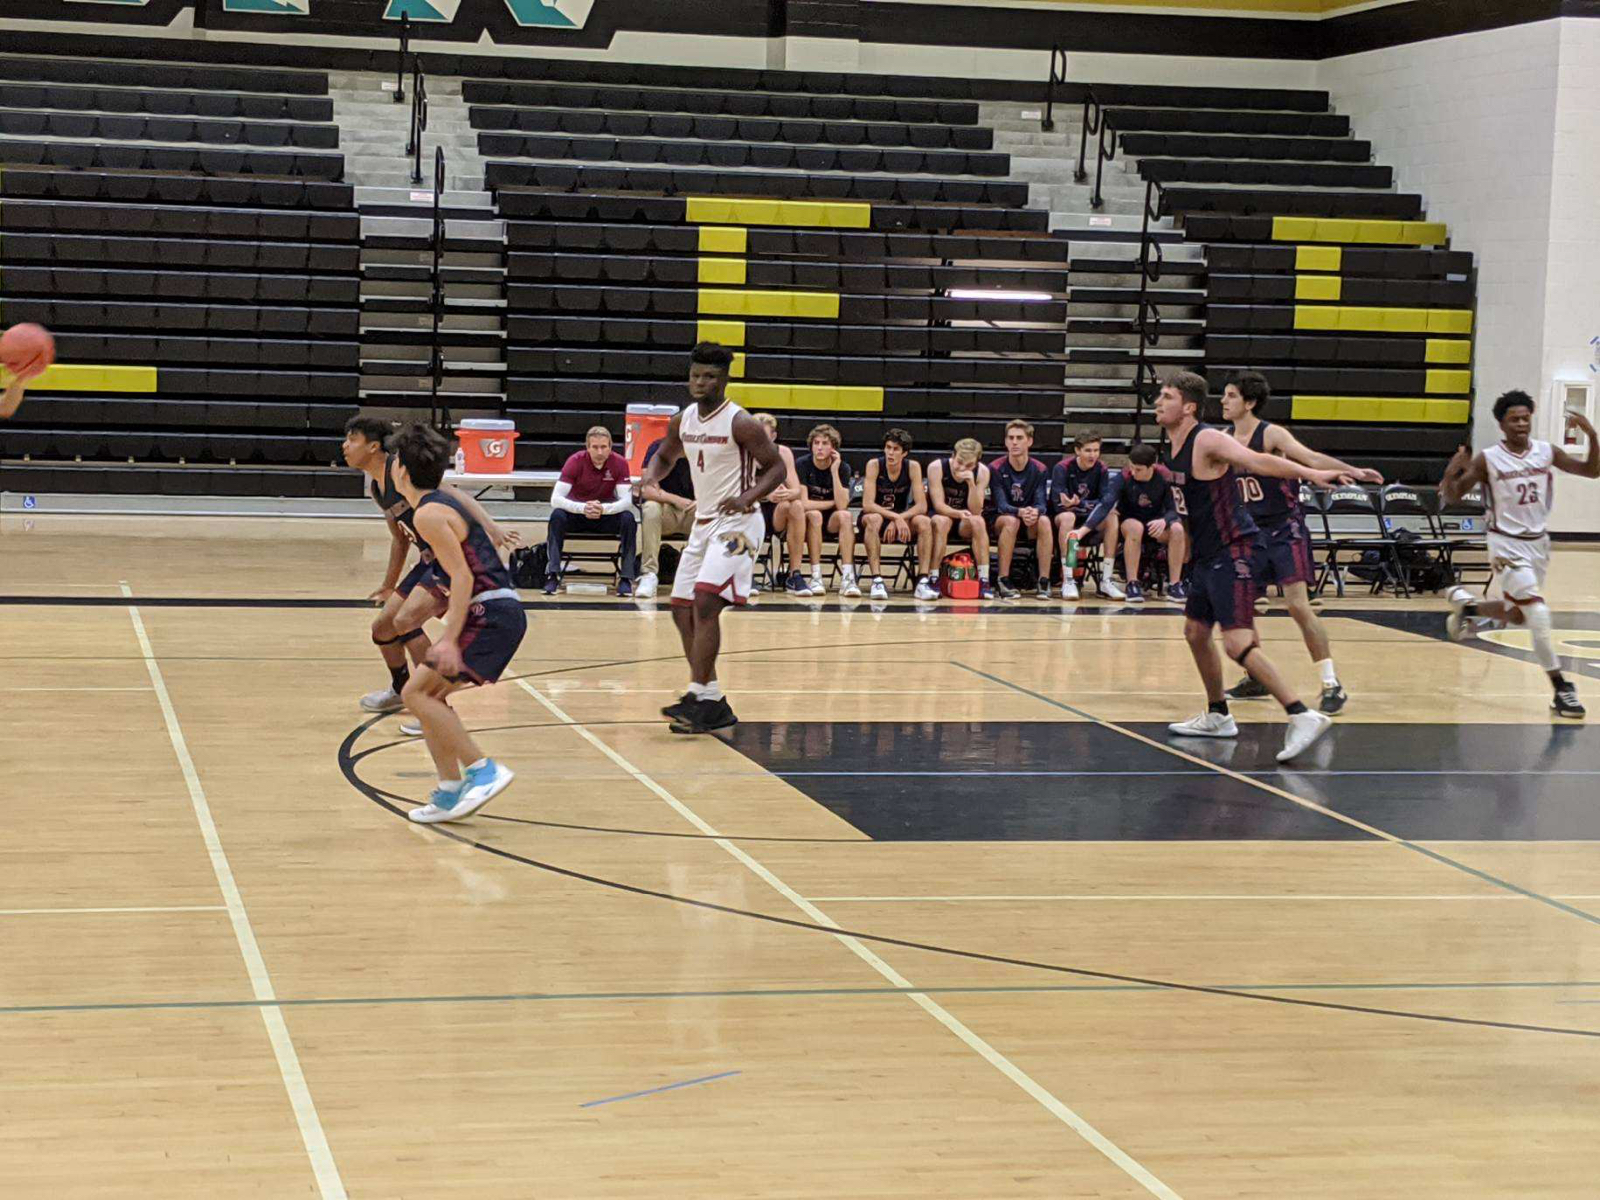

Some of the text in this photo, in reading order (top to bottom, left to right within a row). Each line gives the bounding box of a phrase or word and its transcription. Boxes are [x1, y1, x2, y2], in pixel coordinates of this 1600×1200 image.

[697, 450, 704, 472] 4
[1236, 476, 1264, 502] 10
[1516, 482, 1539, 505] 23
